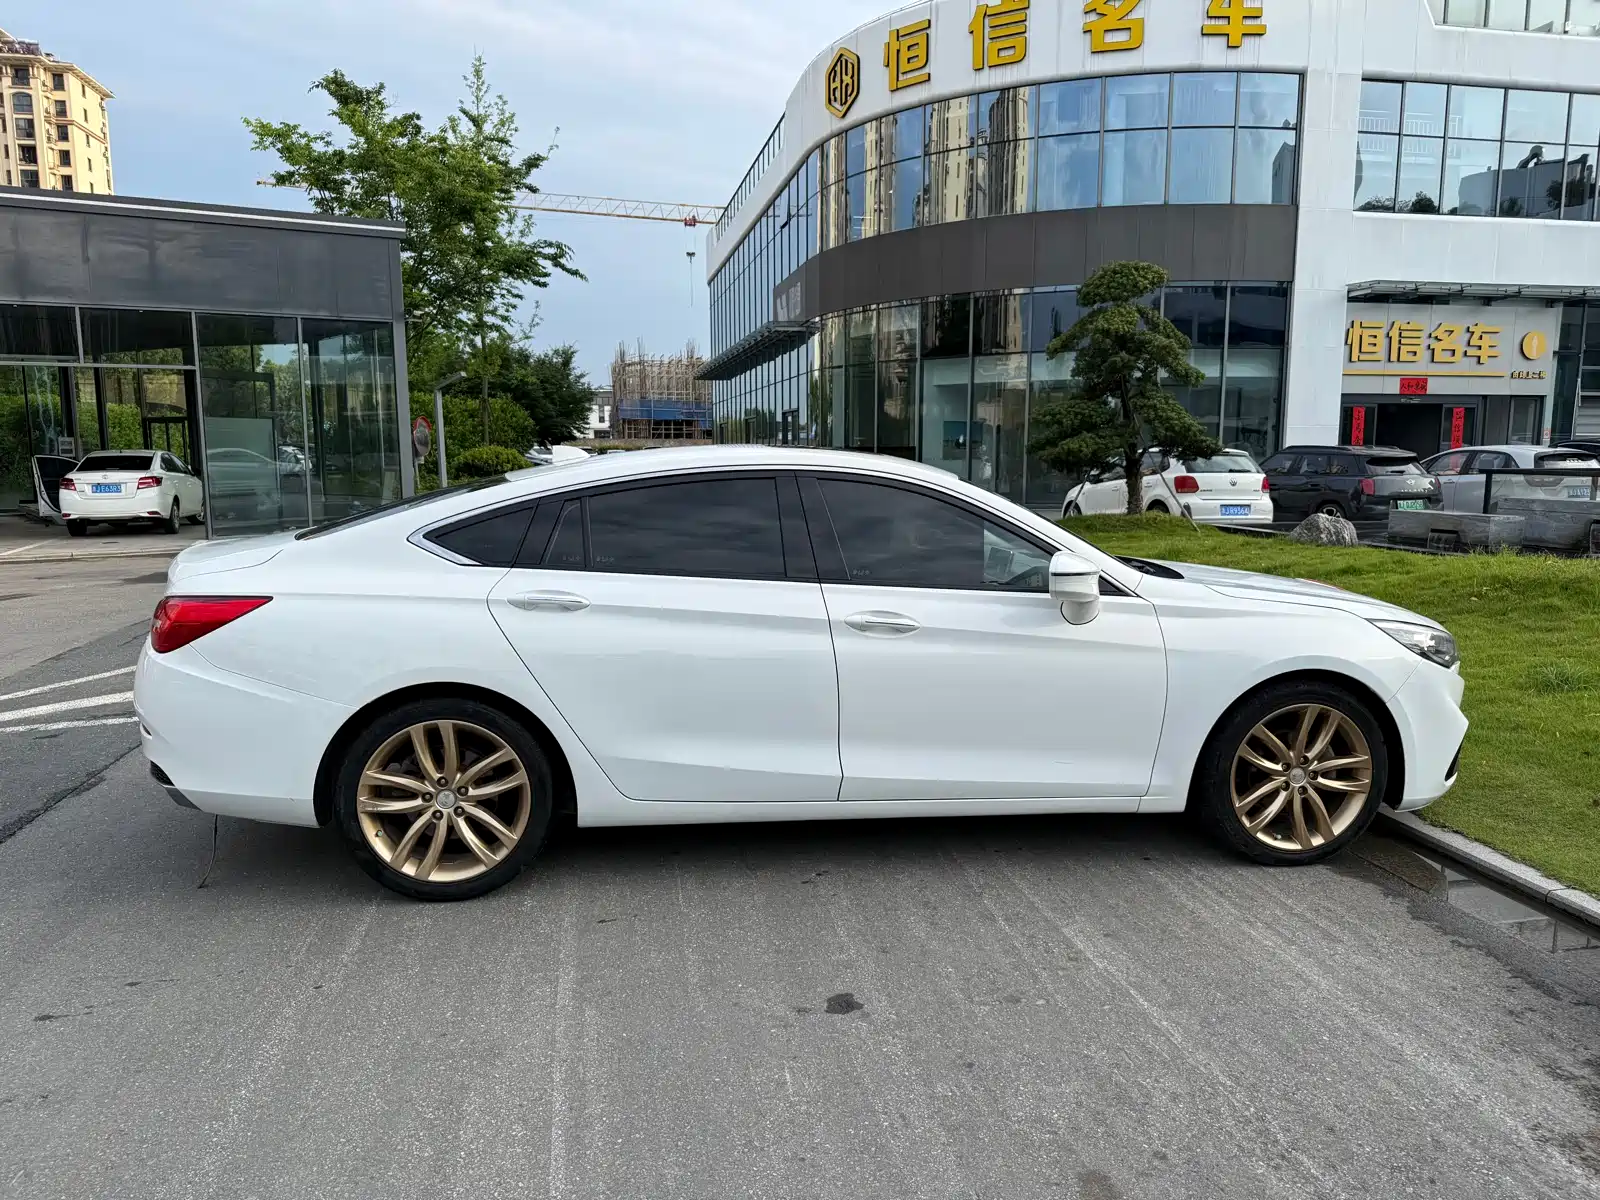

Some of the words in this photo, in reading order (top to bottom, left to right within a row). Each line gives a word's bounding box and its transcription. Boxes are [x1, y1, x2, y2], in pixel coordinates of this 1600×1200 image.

[884, 0, 1267, 91] 恒信名车
[1346, 319, 1503, 364] 恒信名车
